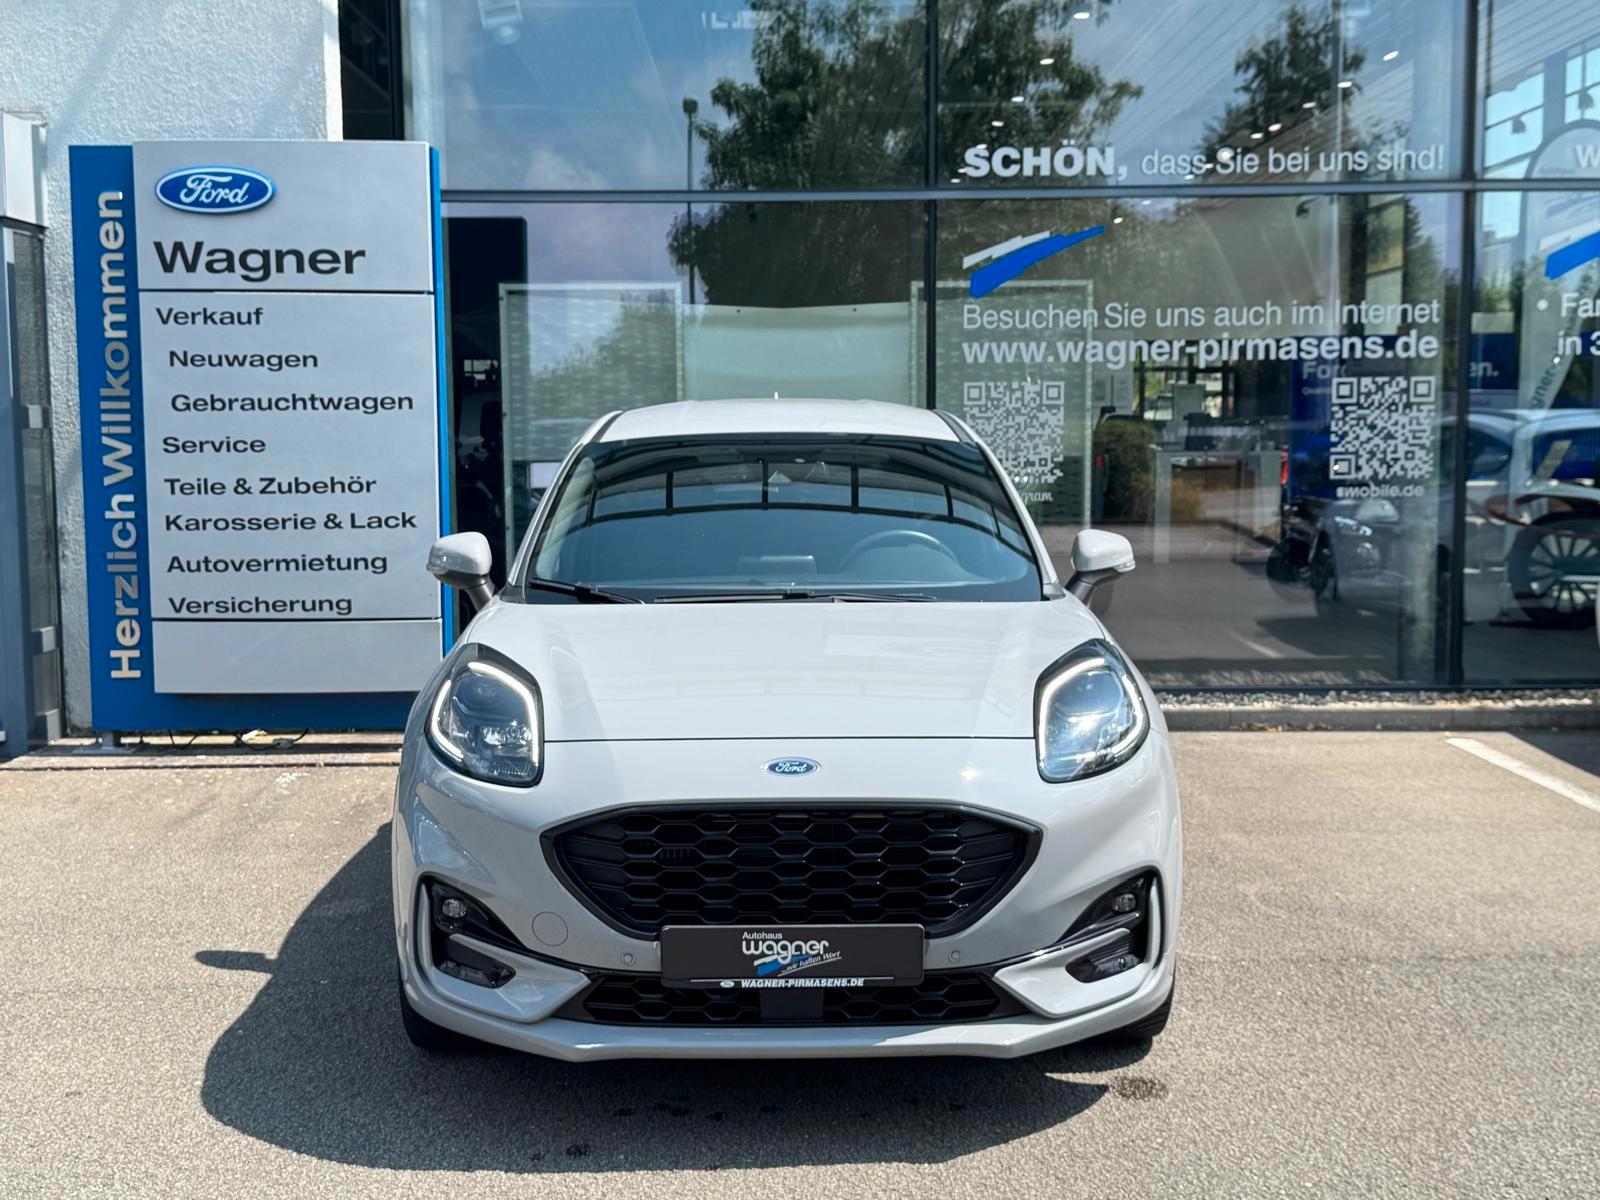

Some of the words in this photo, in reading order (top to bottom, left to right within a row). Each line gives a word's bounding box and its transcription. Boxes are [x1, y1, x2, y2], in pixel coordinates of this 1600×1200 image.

[964, 140, 1128, 180] SCHÖN,
[1142, 149, 1207, 175] dass
[1216, 147, 1260, 174] Sie
[1268, 146, 1311, 173] bei
[1319, 147, 1369, 171] uns
[1376, 145, 1445, 171] sind!
[179, 173, 250, 205] Ford
[153, 240, 366, 283] Wagner
[156, 307, 264, 326] Verkauf
[963, 304, 1098, 329] Besuchen
[1105, 302, 1146, 328] Sie
[1156, 306, 1205, 328] uns
[1214, 302, 1282, 327] auch
[1291, 301, 1324, 325] im
[1335, 300, 1440, 324] Internet
[98, 191, 134, 487] Willkommen
[962, 330, 1439, 370] www.wagner-pirmasens.de
[1557, 330, 1583, 356] in
[169, 349, 319, 371] Neuwagen
[171, 392, 413, 414] Gebrauchtwagen
[162, 436, 266, 453] Service
[164, 478, 226, 495] Teile
[233, 478, 252, 495] &
[259, 476, 377, 494] Zubehör
[165, 513, 316, 531] Karosserie
[323, 513, 343, 530] &
[350, 511, 417, 529] Lack
[167, 554, 388, 574] Autovermietung
[105, 493, 142, 679] Herzlich
[168, 596, 352, 615] Versicherung
[742, 931, 783, 940] Autohaus
[742, 940, 830, 964] wagner
[822, 950, 840, 960] Wort
[741, 978, 865, 988] WAGNER-PIRMASENS.DE
